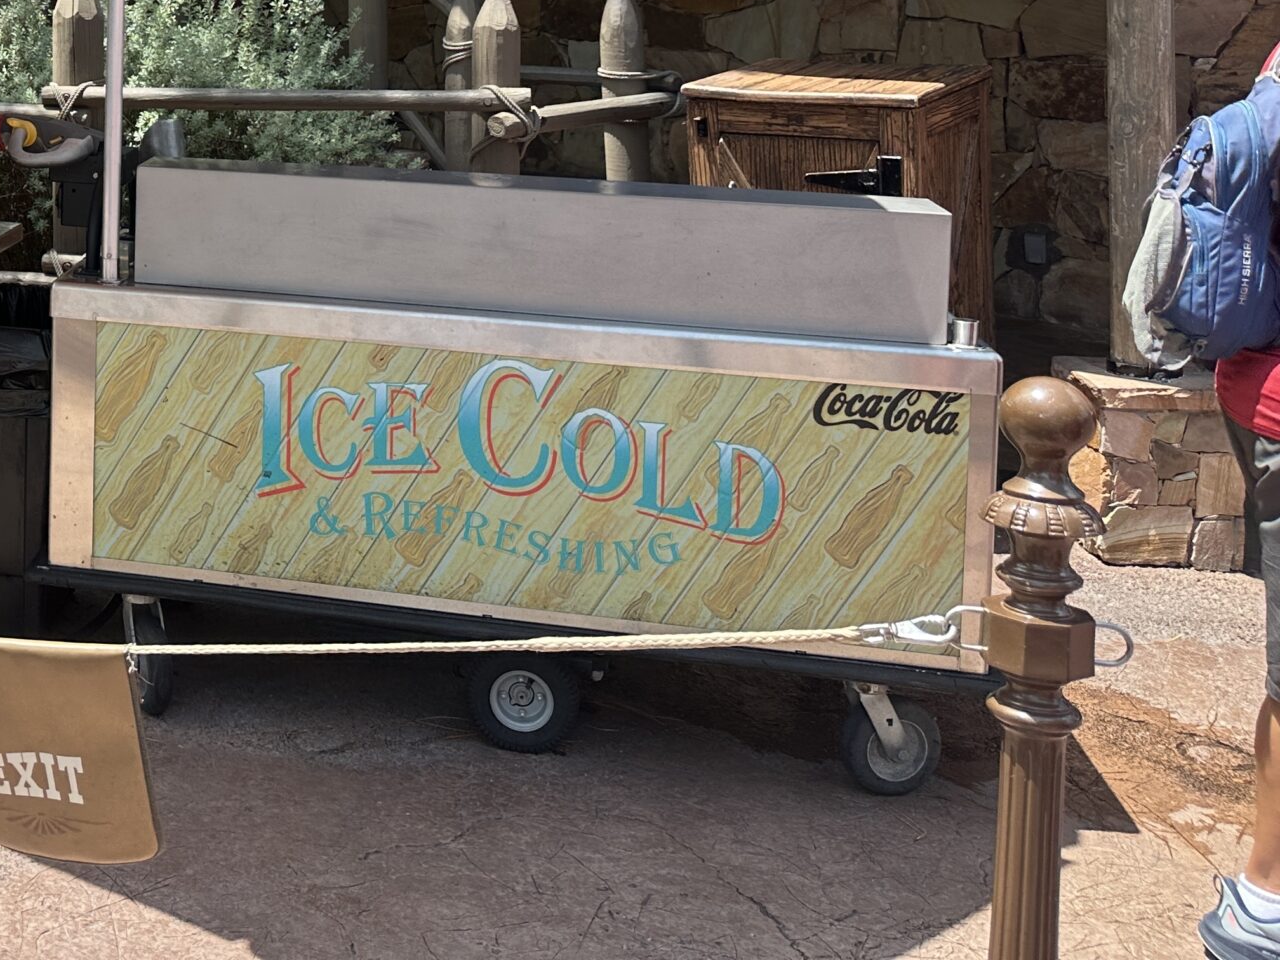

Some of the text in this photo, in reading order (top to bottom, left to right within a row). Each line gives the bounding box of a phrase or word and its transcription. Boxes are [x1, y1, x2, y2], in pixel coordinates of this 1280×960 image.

[1237, 234, 1253, 306] HIGH SIERRA
[812, 382, 965, 436] Coca-Cola
[252, 358, 788, 547] ICE COLD
[309, 491, 683, 575] & REFRESHING
